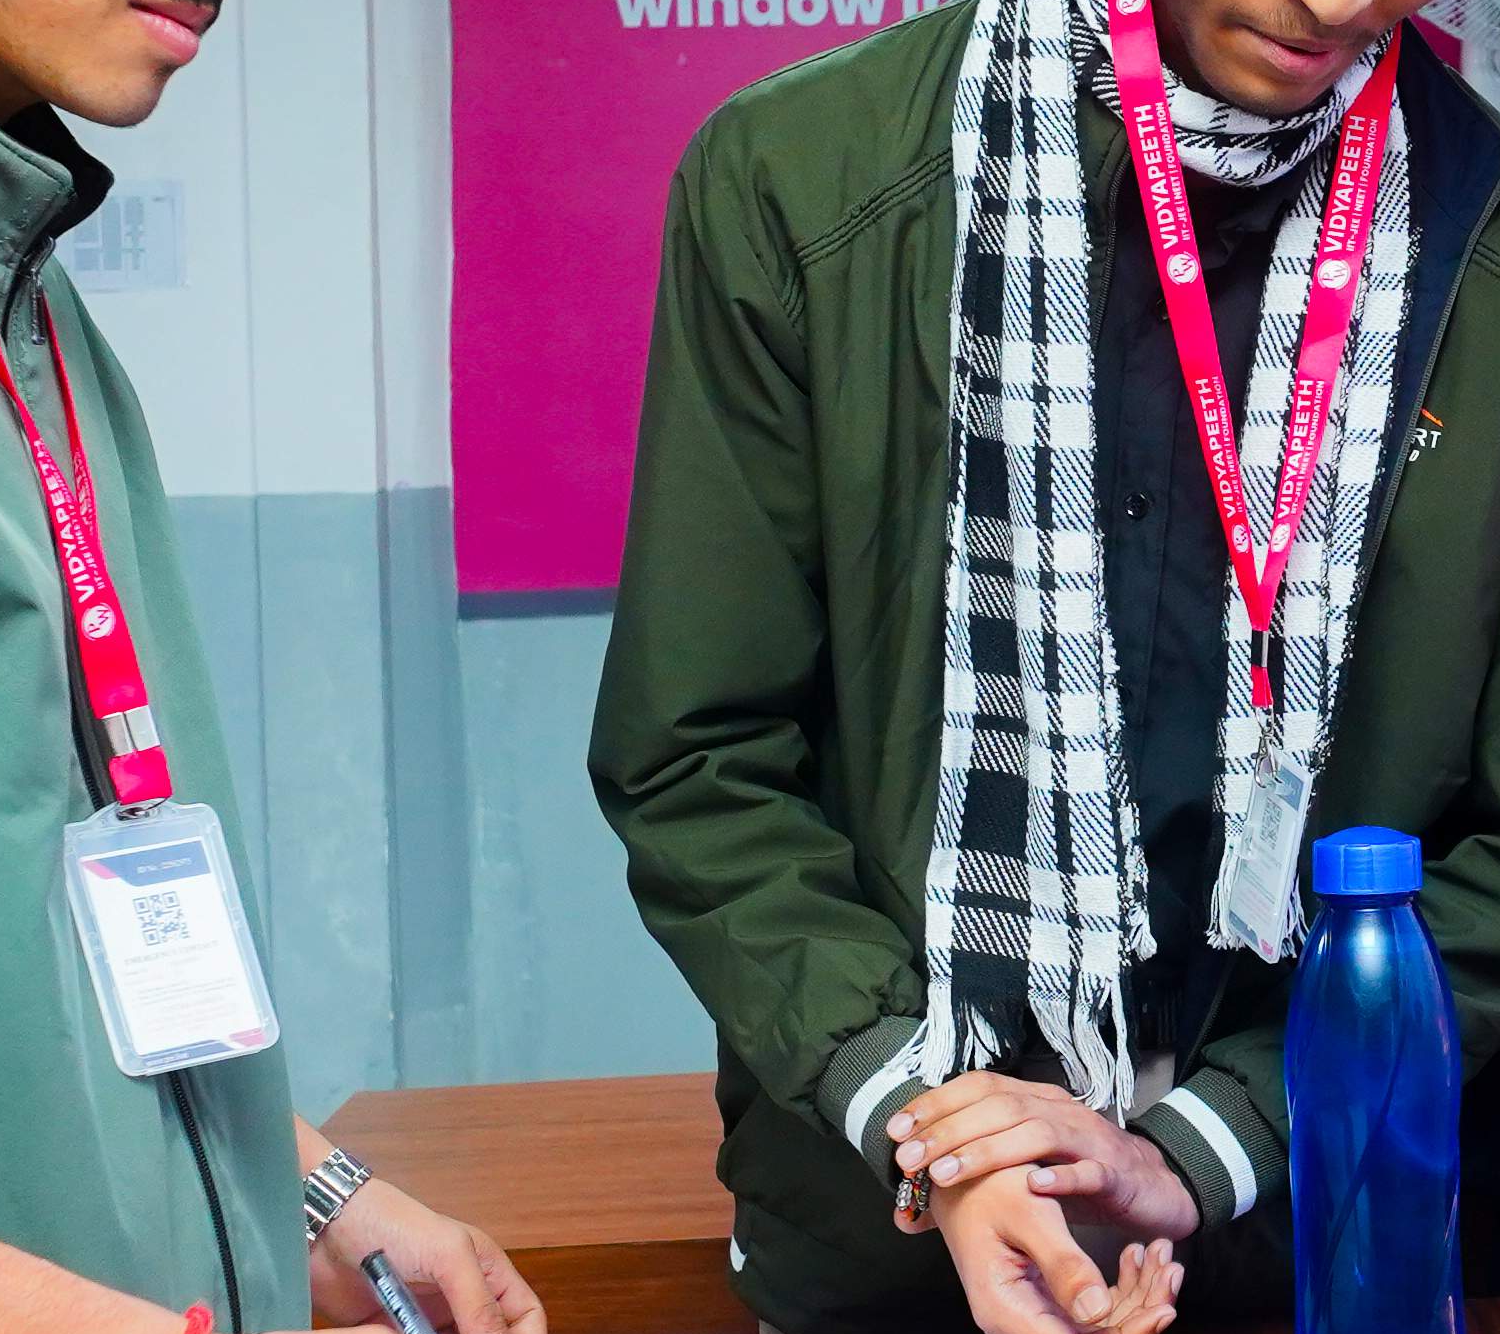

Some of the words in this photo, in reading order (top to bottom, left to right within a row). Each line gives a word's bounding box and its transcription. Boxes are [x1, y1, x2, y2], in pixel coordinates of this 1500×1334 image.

[1134, 104, 1178, 249] VIDYAPEETH
[1155, 102, 1176, 168] FOUNDATION
[1324, 115, 1365, 252] VIDYAPEETH
[1360, 119, 1378, 182] FOUNDATION
[1195, 378, 1236, 518] VIDYAPEETH
[1212, 376, 1230, 442] FOUNDATION
[1278, 380, 1314, 519] VIDYAPEETH
[1308, 381, 1324, 445] FOUNDATION
[33, 438, 95, 603] VIDYAPEETH
